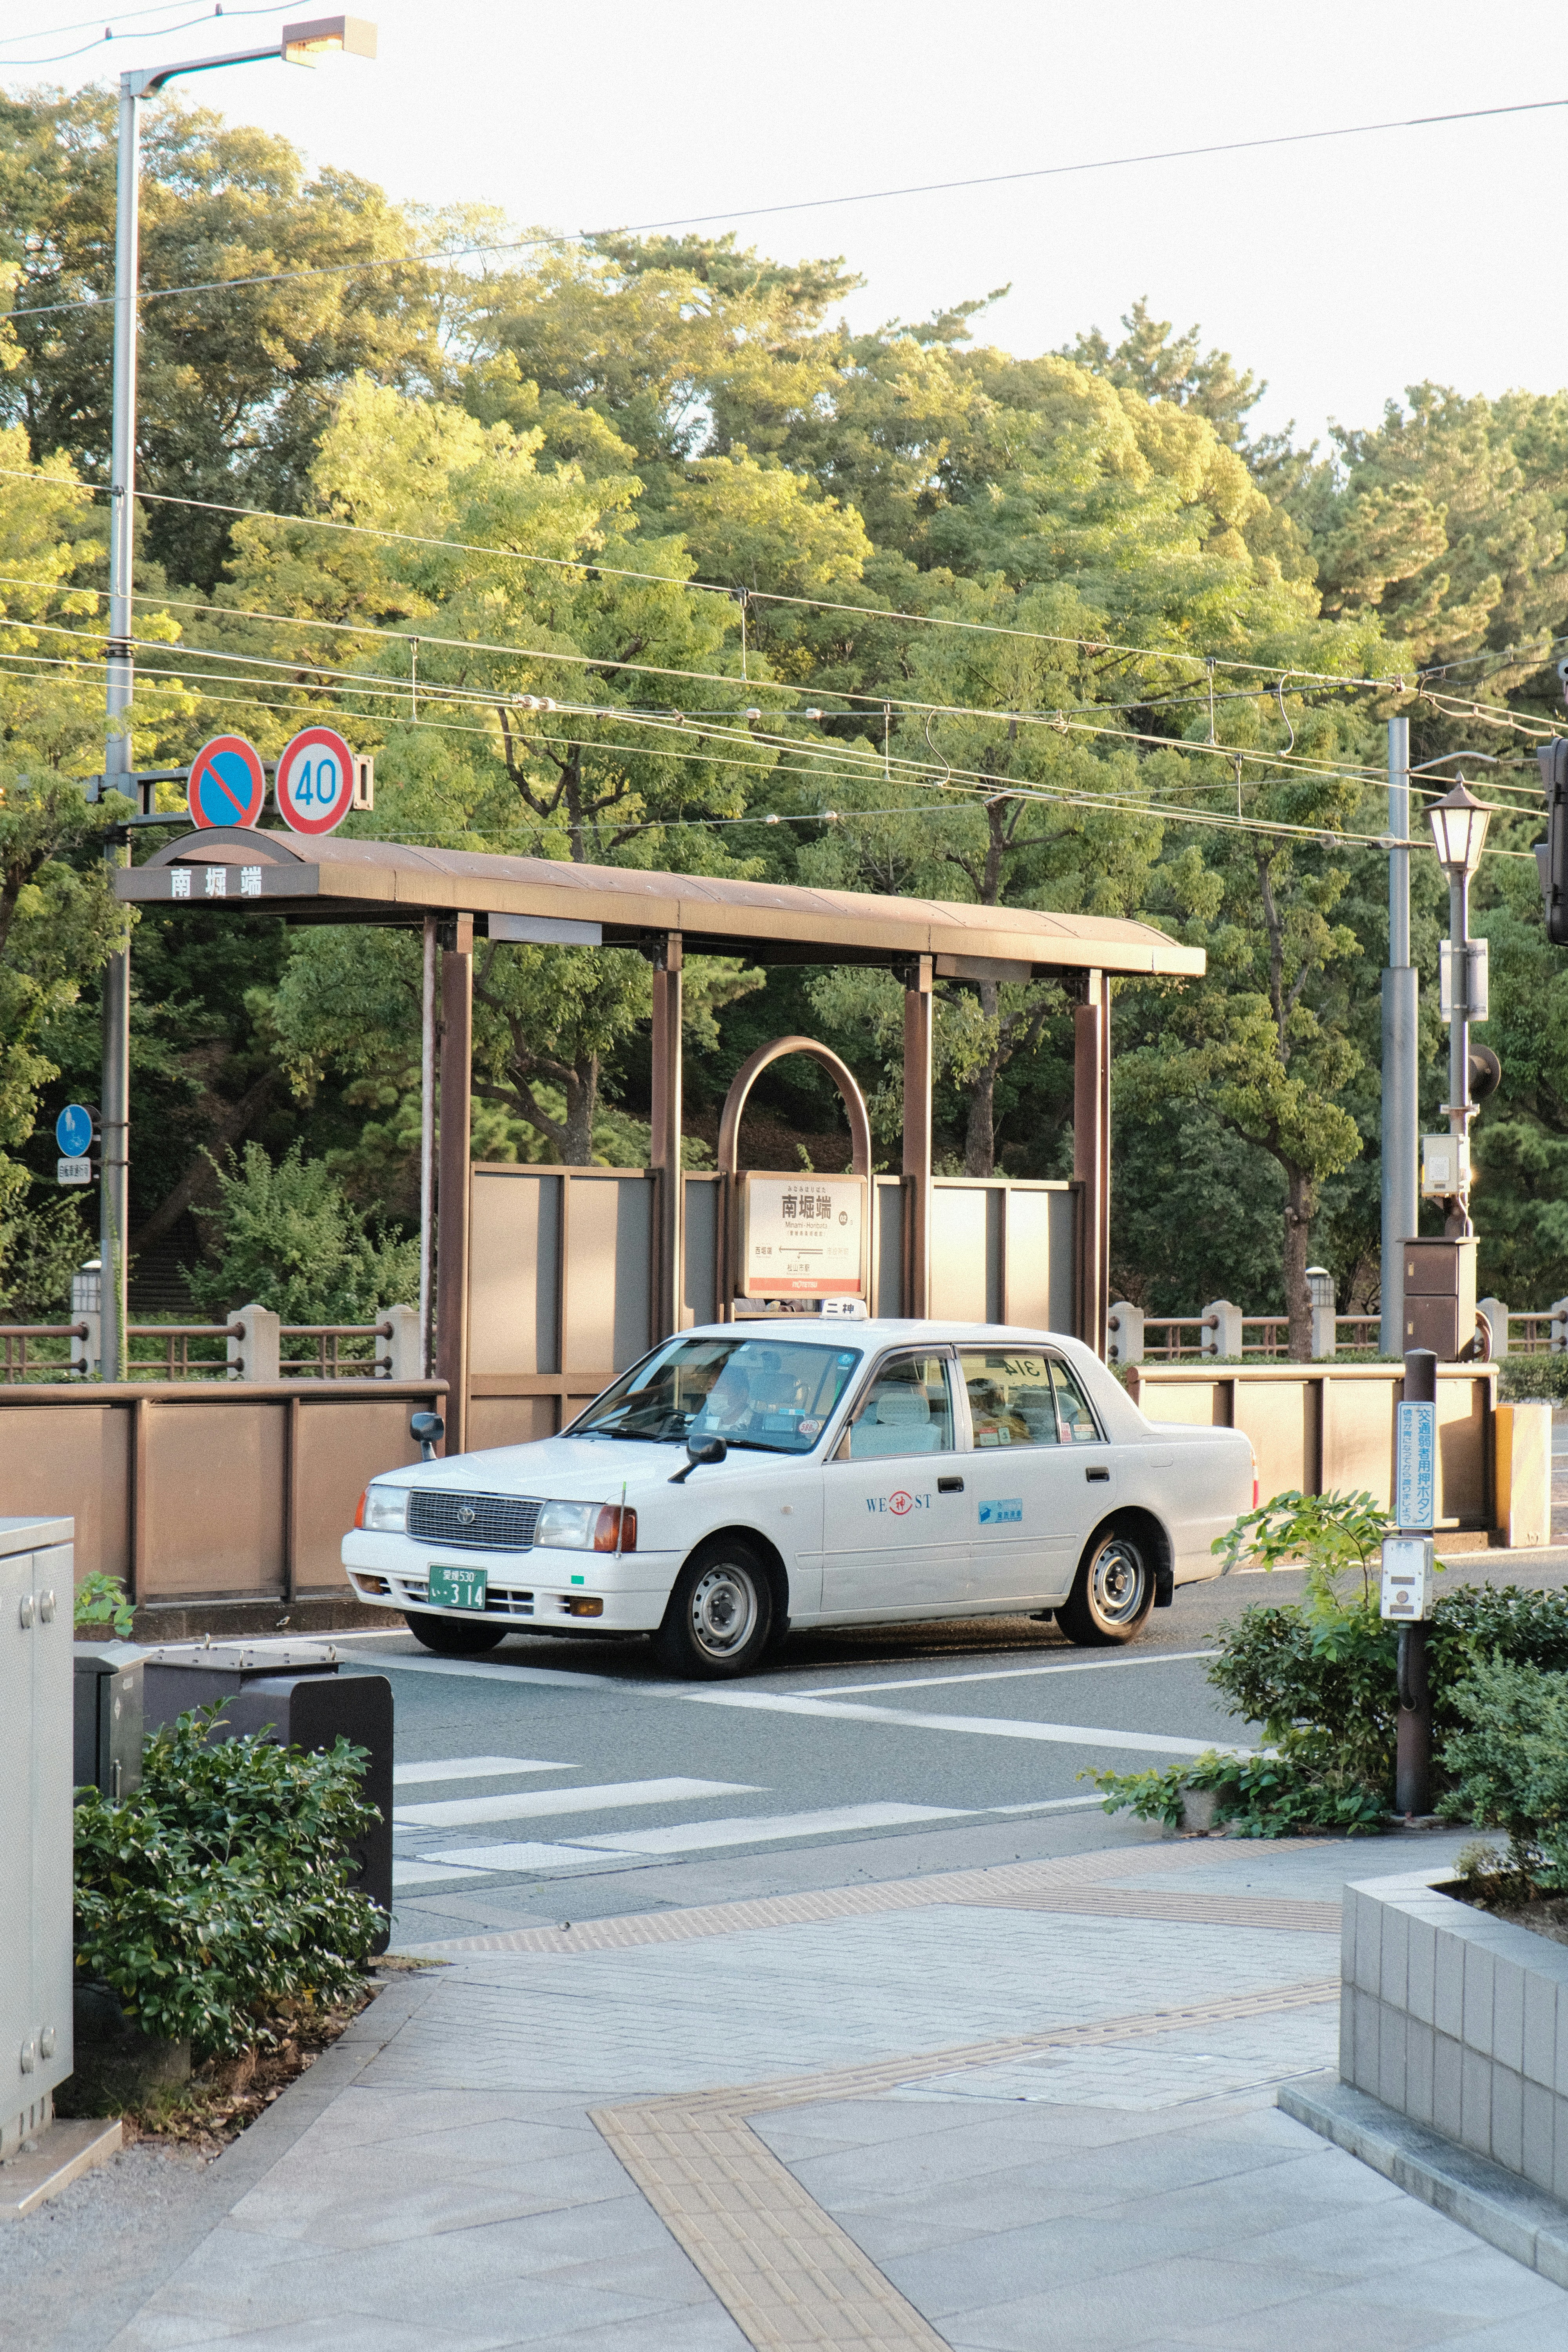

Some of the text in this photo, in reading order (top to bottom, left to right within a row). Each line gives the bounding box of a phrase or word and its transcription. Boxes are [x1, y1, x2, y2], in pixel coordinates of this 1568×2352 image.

[296, 759, 336, 805] 40
[171, 866, 262, 898] 南堀端
[782, 1194, 831, 1219] 南堀端
[826, 1303, 855, 1314] 二神
[1417, 1409, 1431, 1522] 交通弱者用押ボタン
